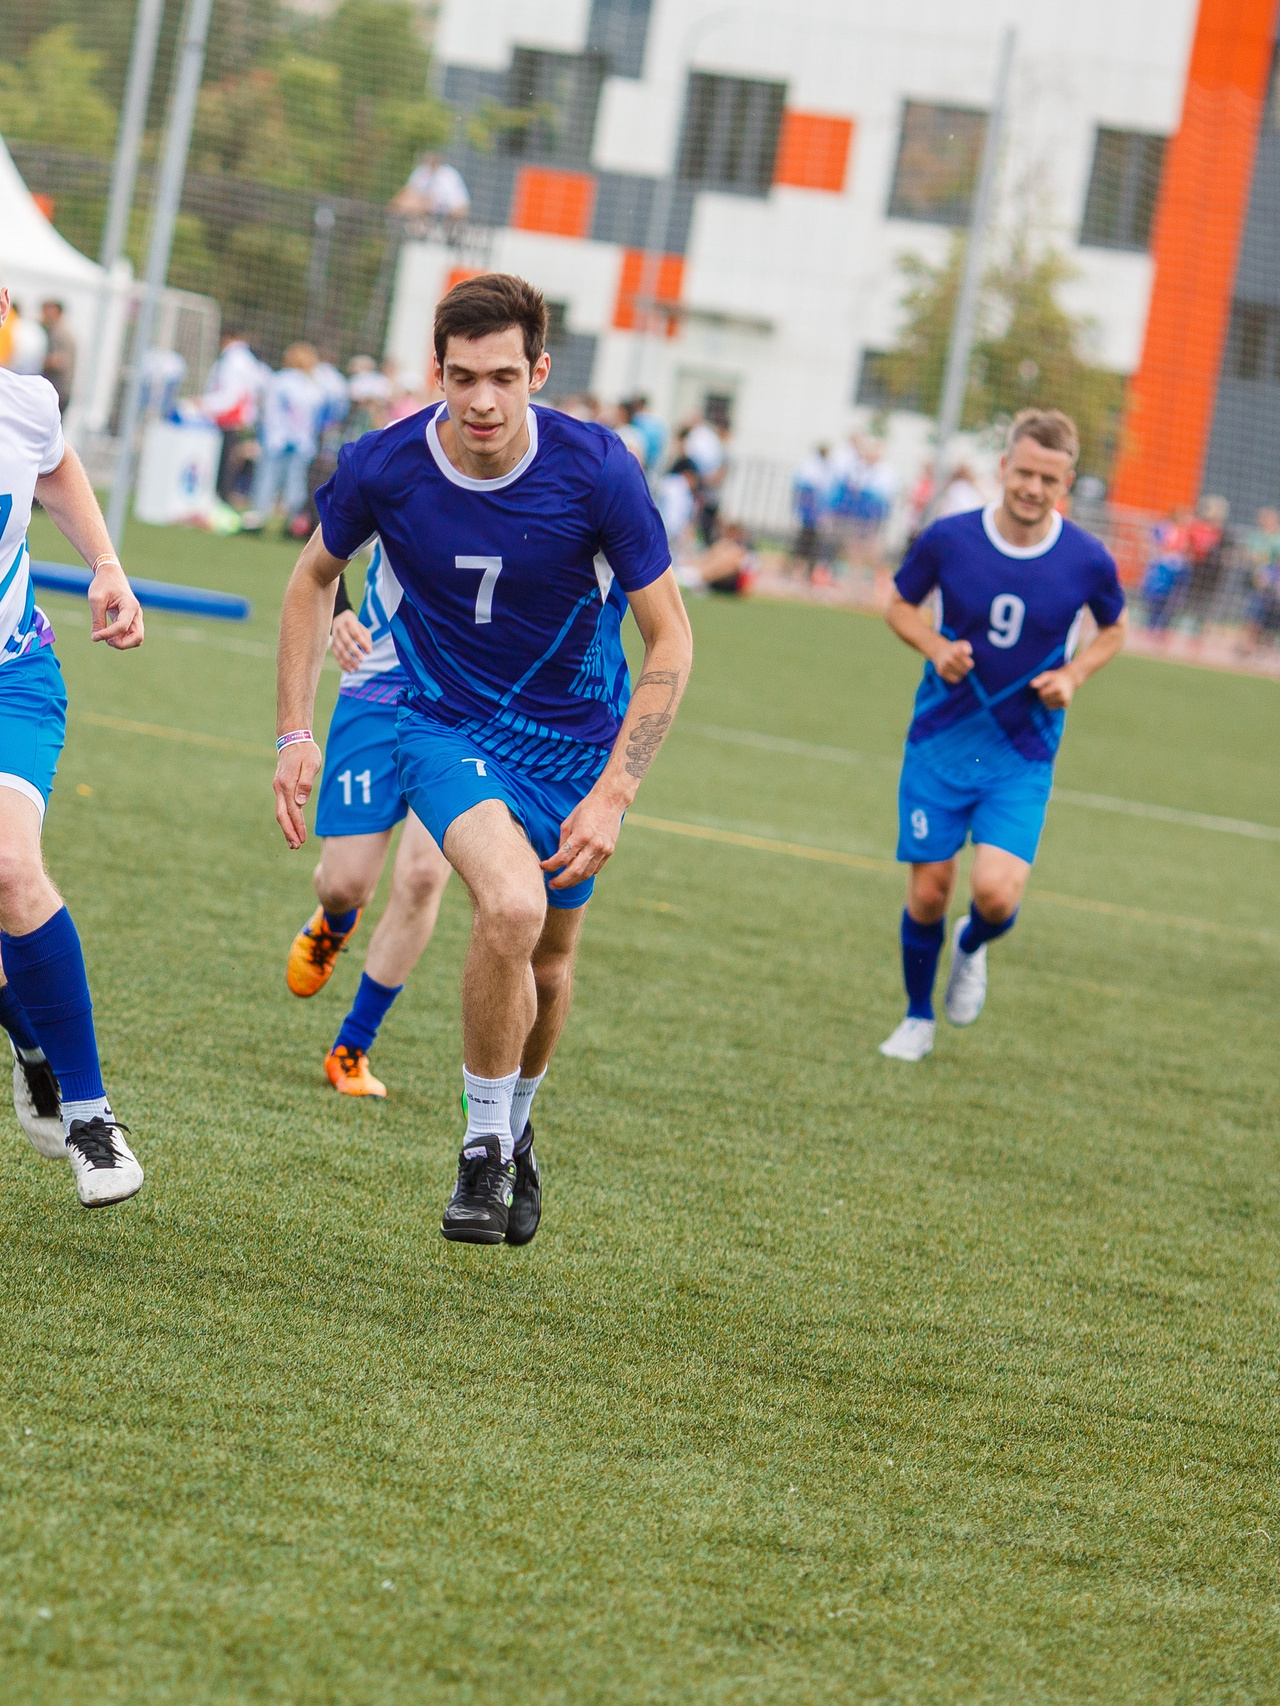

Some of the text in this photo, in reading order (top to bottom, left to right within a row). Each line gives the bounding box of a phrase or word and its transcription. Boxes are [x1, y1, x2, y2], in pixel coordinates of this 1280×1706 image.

[455, 555, 503, 624] 7
[987, 593, 1026, 649] 9
[337, 769, 371, 805] 11
[911, 809, 928, 839] 9
